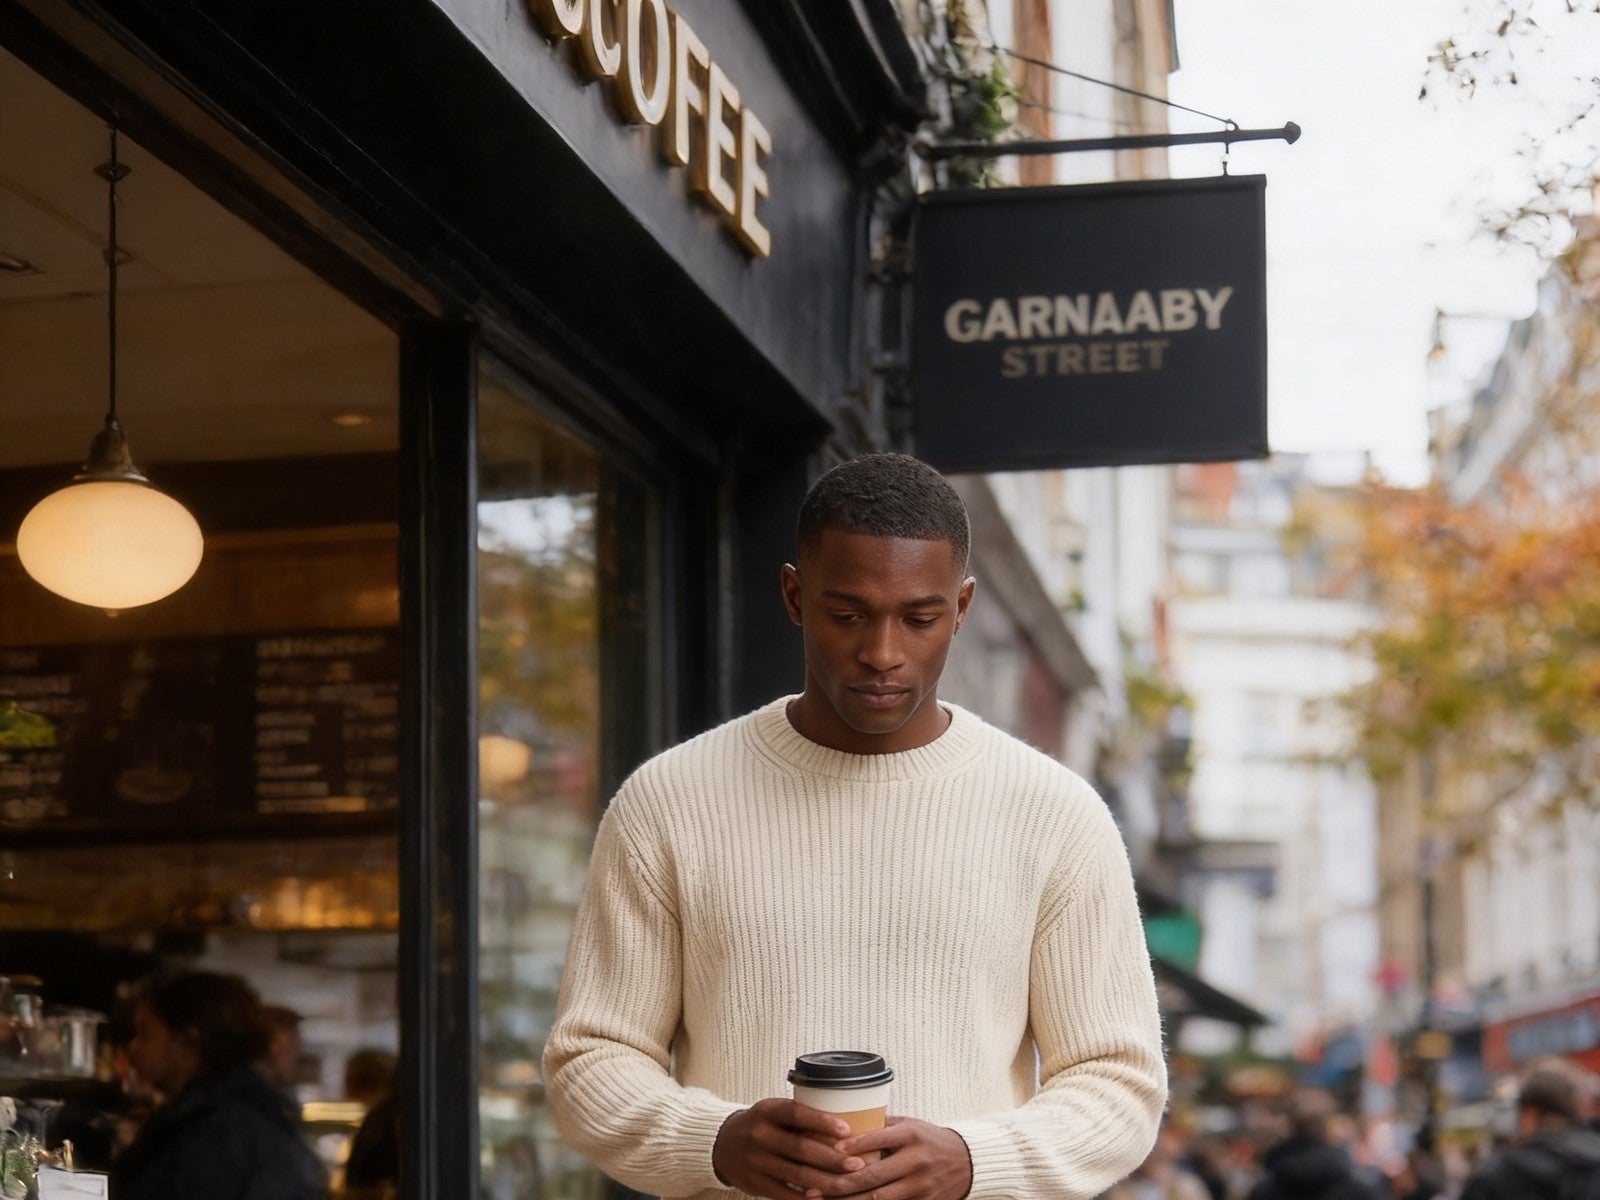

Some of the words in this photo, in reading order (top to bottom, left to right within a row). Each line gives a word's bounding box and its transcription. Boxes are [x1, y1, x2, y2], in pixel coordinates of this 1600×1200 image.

[545, 0, 772, 258] COFEE
[944, 286, 1234, 343] GARNAABY
[1001, 340, 1170, 379] STREET
